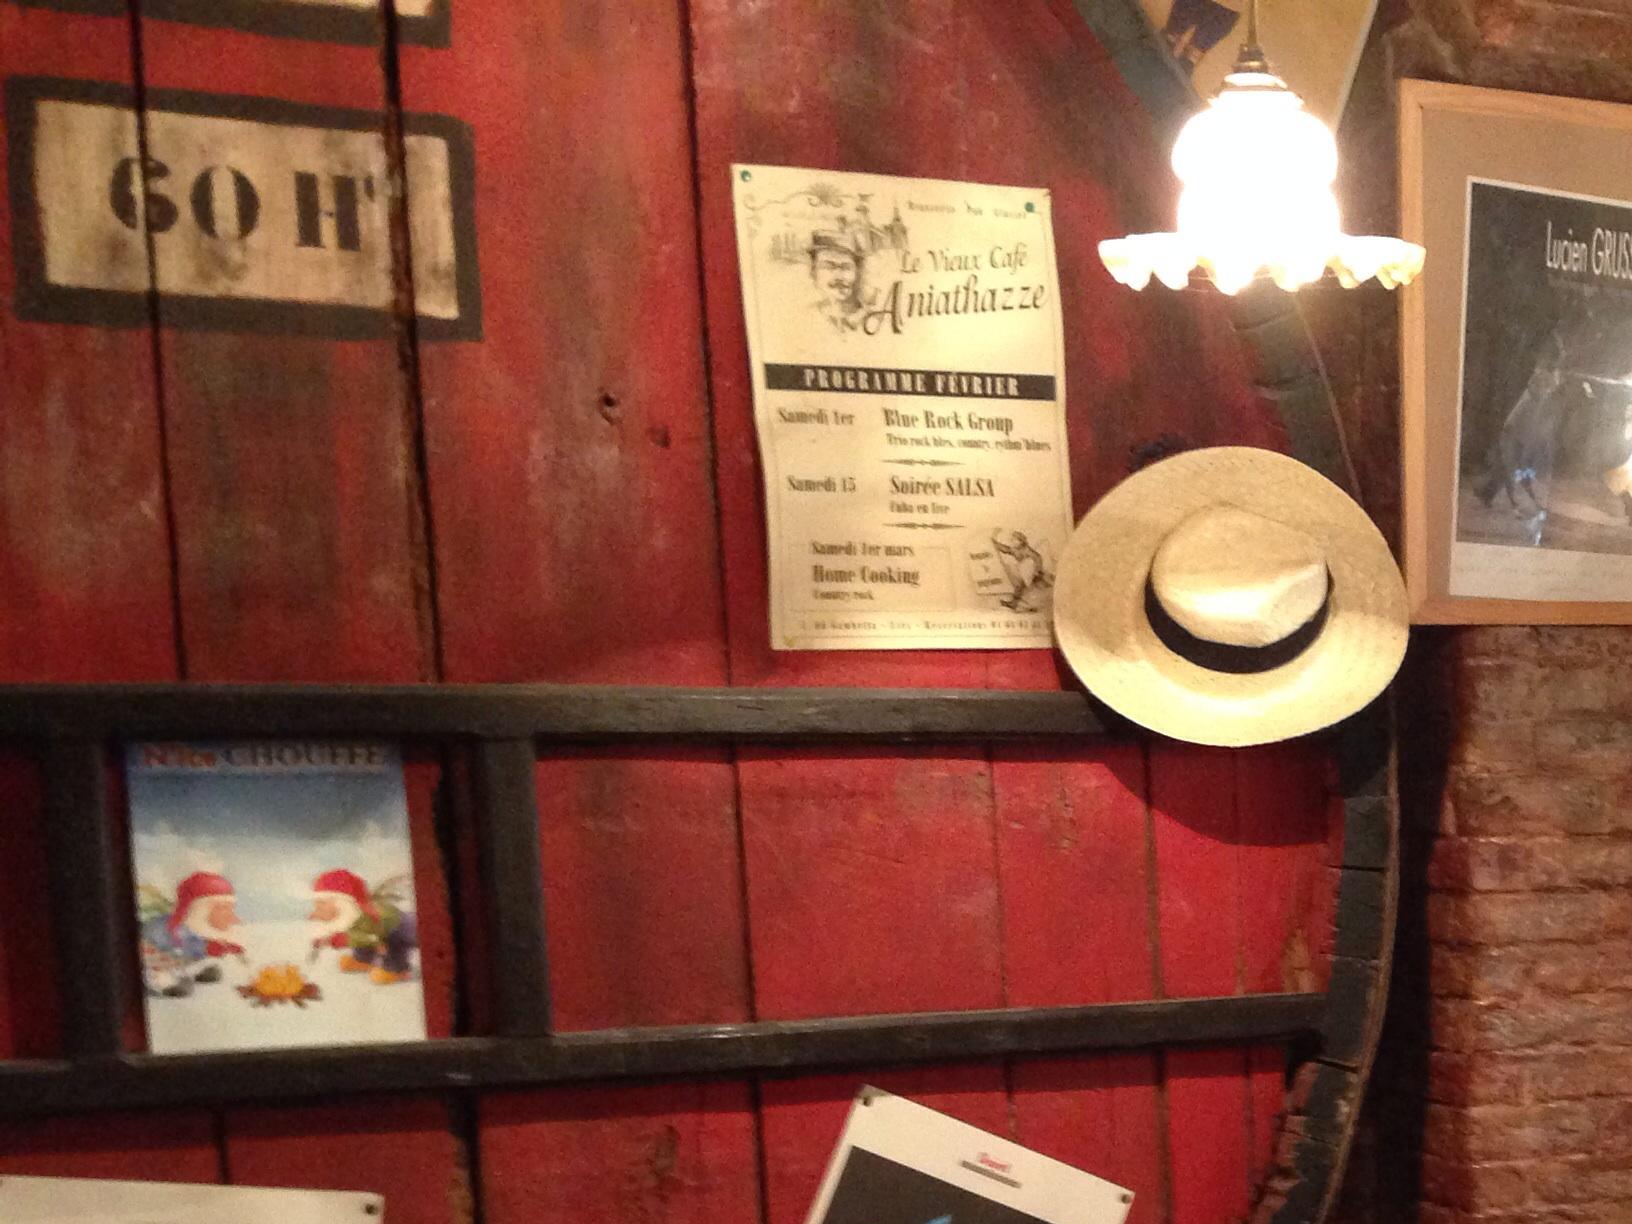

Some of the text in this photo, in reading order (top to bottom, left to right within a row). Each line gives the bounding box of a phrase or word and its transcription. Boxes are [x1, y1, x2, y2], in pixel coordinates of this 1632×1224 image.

[109, 157, 261, 241] 60
[901, 241, 1028, 275] Le Vieux Café
[1545, 220, 1588, 273] Lucien
[803, 368, 1020, 397] PROGRAMME FÉVRIER
[778, 407, 856, 427] Samedi 1er
[883, 407, 1014, 437] Blue Rock Group
[787, 475, 858, 494] Samedi 15
[889, 474, 995, 498] Soirée SALSA
[811, 539, 857, 557] Samedi
[812, 563, 921, 589] Home Cooking
